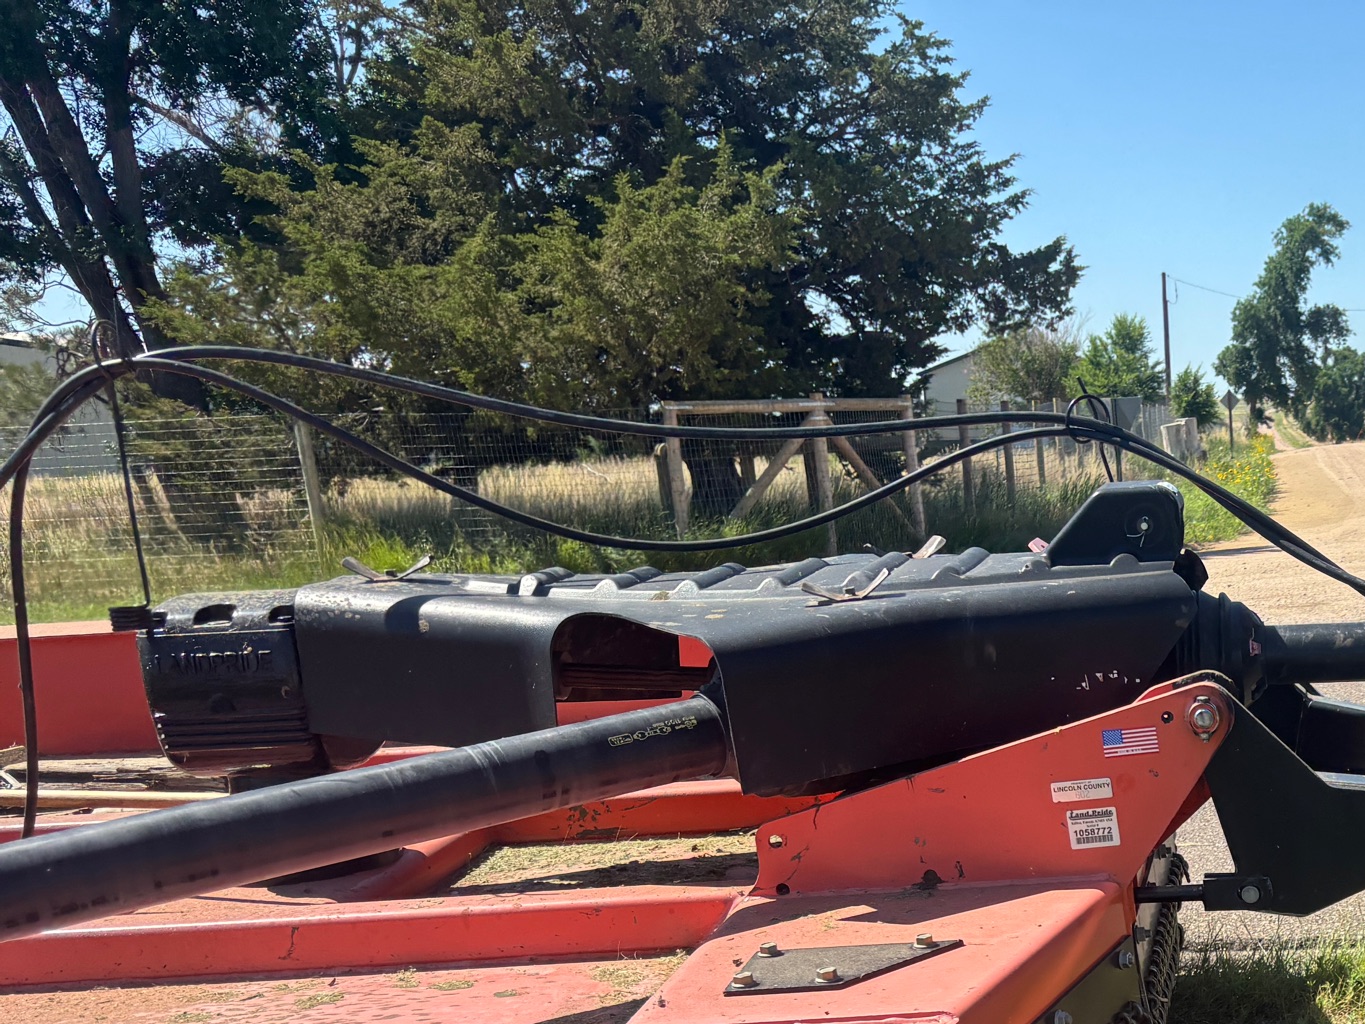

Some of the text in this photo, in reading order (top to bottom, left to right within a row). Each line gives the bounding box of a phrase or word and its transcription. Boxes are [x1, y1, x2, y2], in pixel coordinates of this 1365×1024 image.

[1053, 782, 1110, 793] LINCOLN COUNTY
[1069, 809, 1114, 819] Land Pride
[1073, 826, 1113, 838] 1058772
